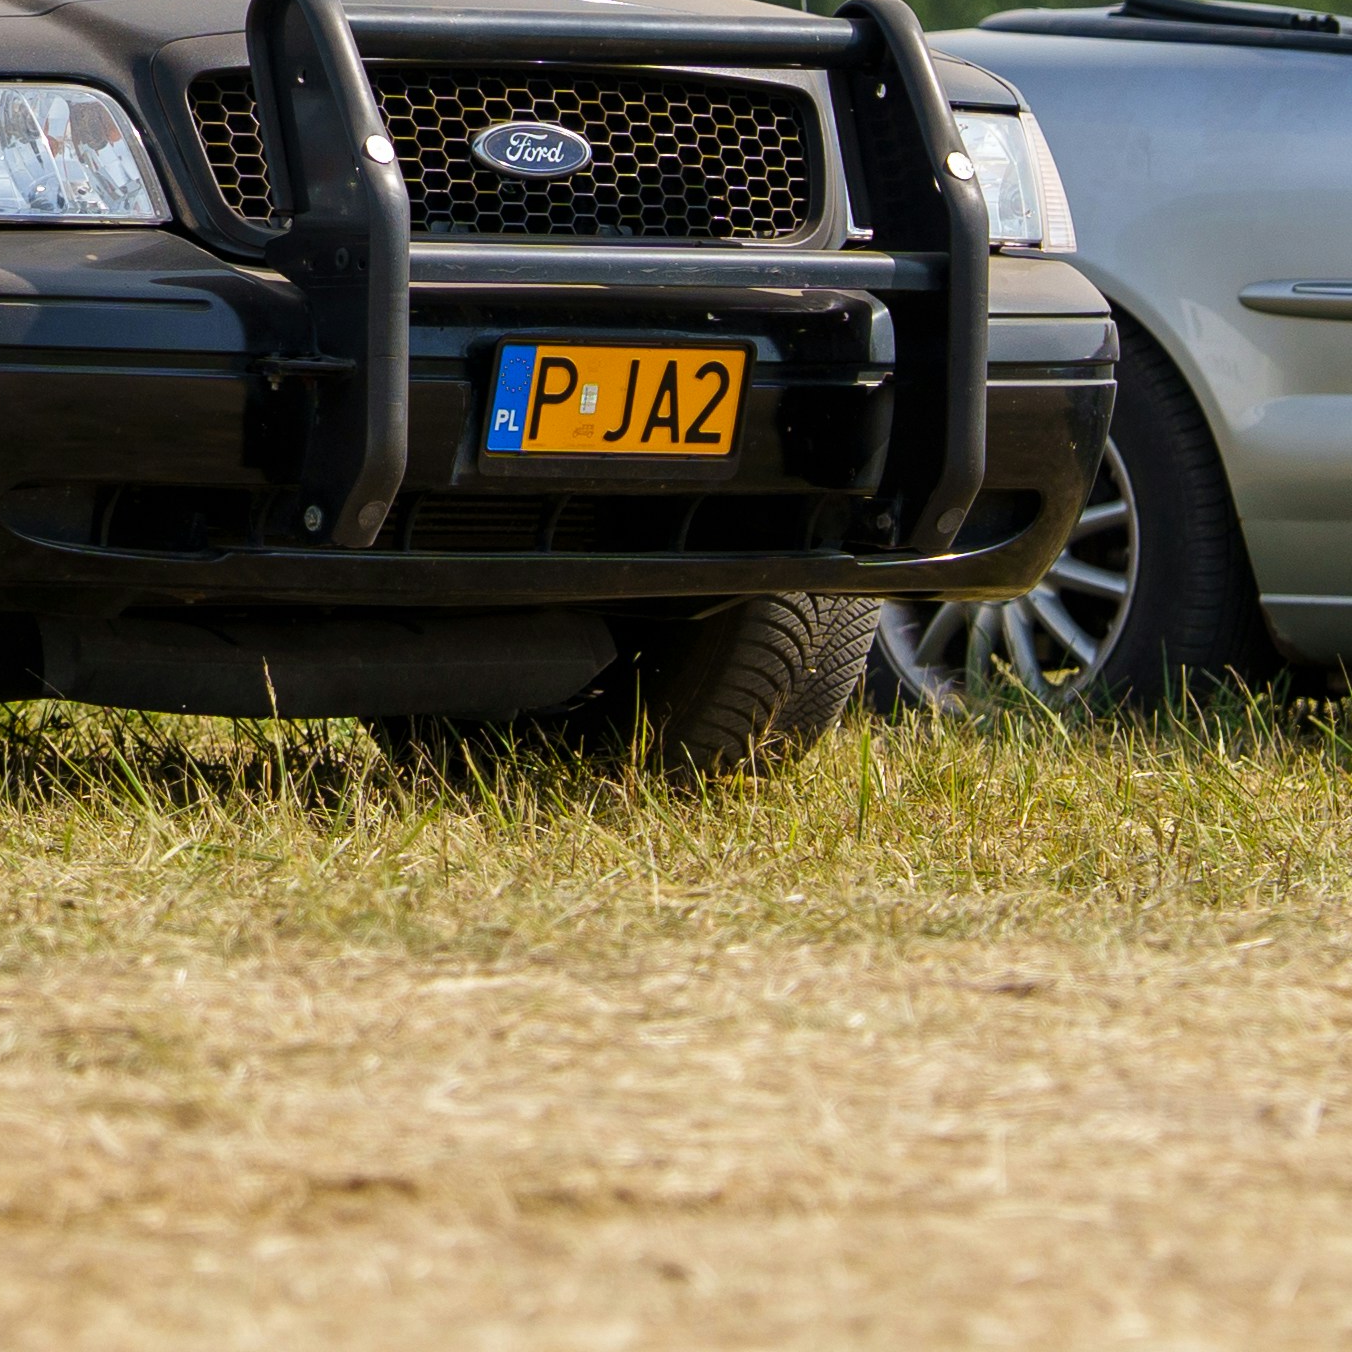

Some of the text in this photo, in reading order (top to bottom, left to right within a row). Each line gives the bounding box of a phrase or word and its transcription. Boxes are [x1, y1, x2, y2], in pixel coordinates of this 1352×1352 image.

[505, 132, 565, 164] Ford
[529, 356, 730, 443] P JA2
[495, 409, 519, 431] PL
